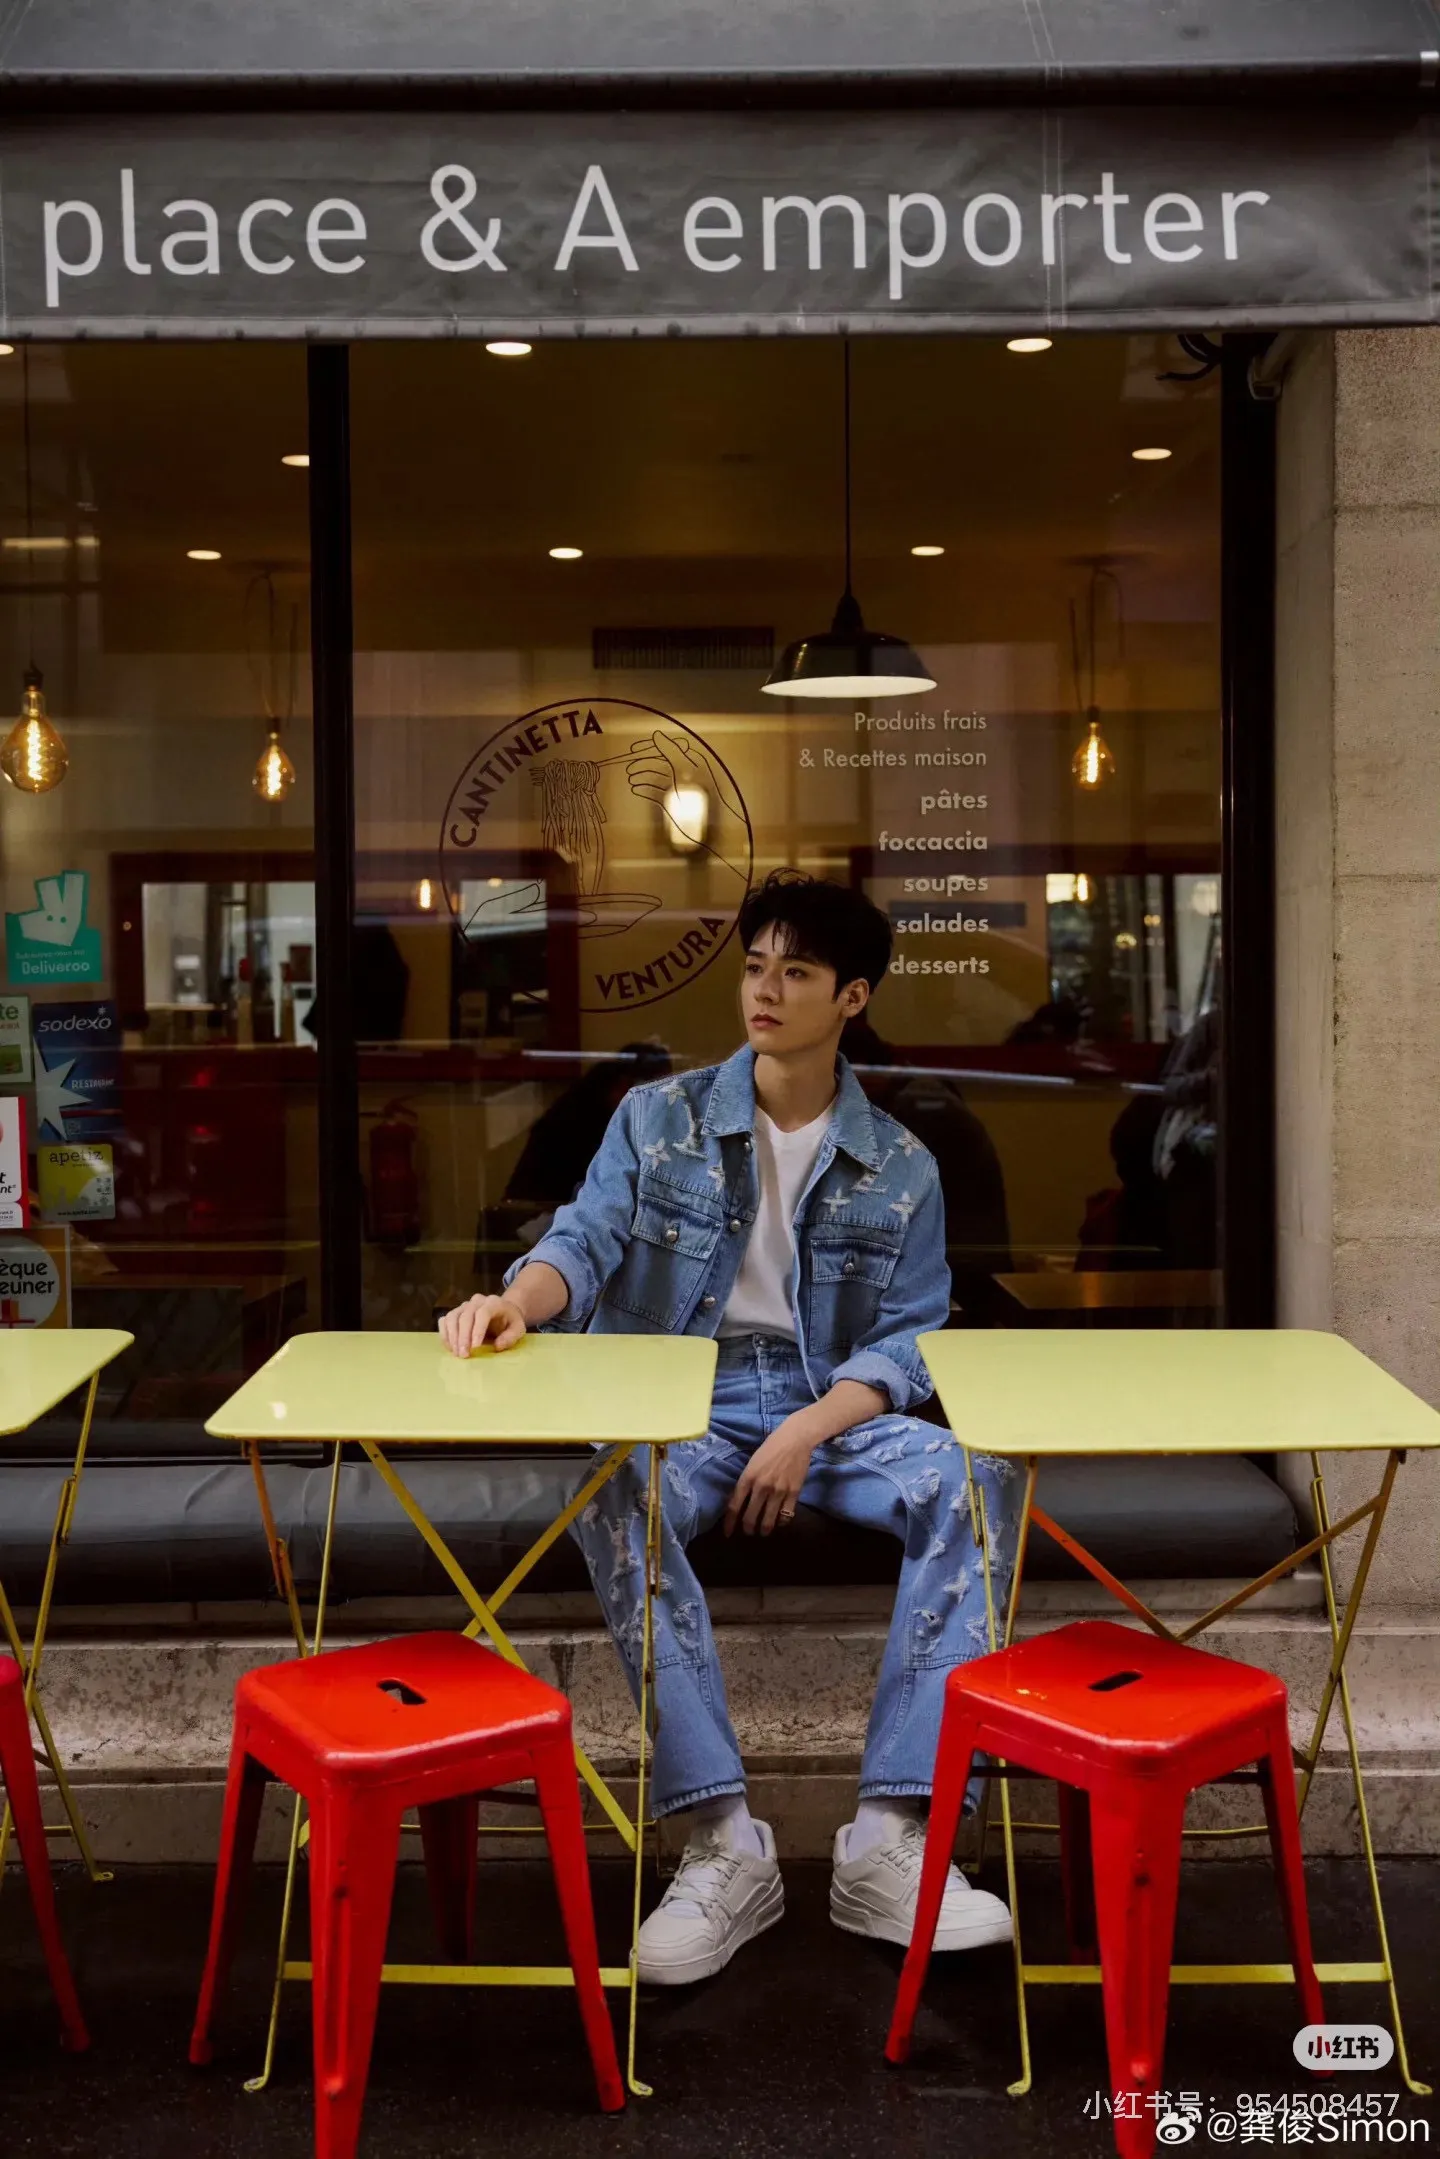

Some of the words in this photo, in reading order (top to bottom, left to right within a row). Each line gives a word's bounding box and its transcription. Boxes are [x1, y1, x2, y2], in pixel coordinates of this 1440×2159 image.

[43, 168, 367, 308] place
[420, 163, 508, 272] &
[554, 164, 640, 271] A
[683, 171, 1271, 300] emporter
[854, 710, 936, 732] Produits
[943, 709, 988, 731] frais
[799, 748, 816, 768] &
[823, 748, 907, 768] Recettes
[914, 747, 987, 766] maison
[449, 708, 604, 848] CANTINETTA
[920, 788, 988, 815] pâtes
[878, 830, 988, 851] foccaccia
[903, 875, 988, 897] soupes
[895, 912, 989, 934] salades
[21, 960, 91, 976] Deliveroo
[594, 915, 726, 1001] VENTURA
[889, 954, 990, 975] desserts
[38, 1014, 112, 1032] sodexo
[49, 1146, 104, 1167] apetiz
